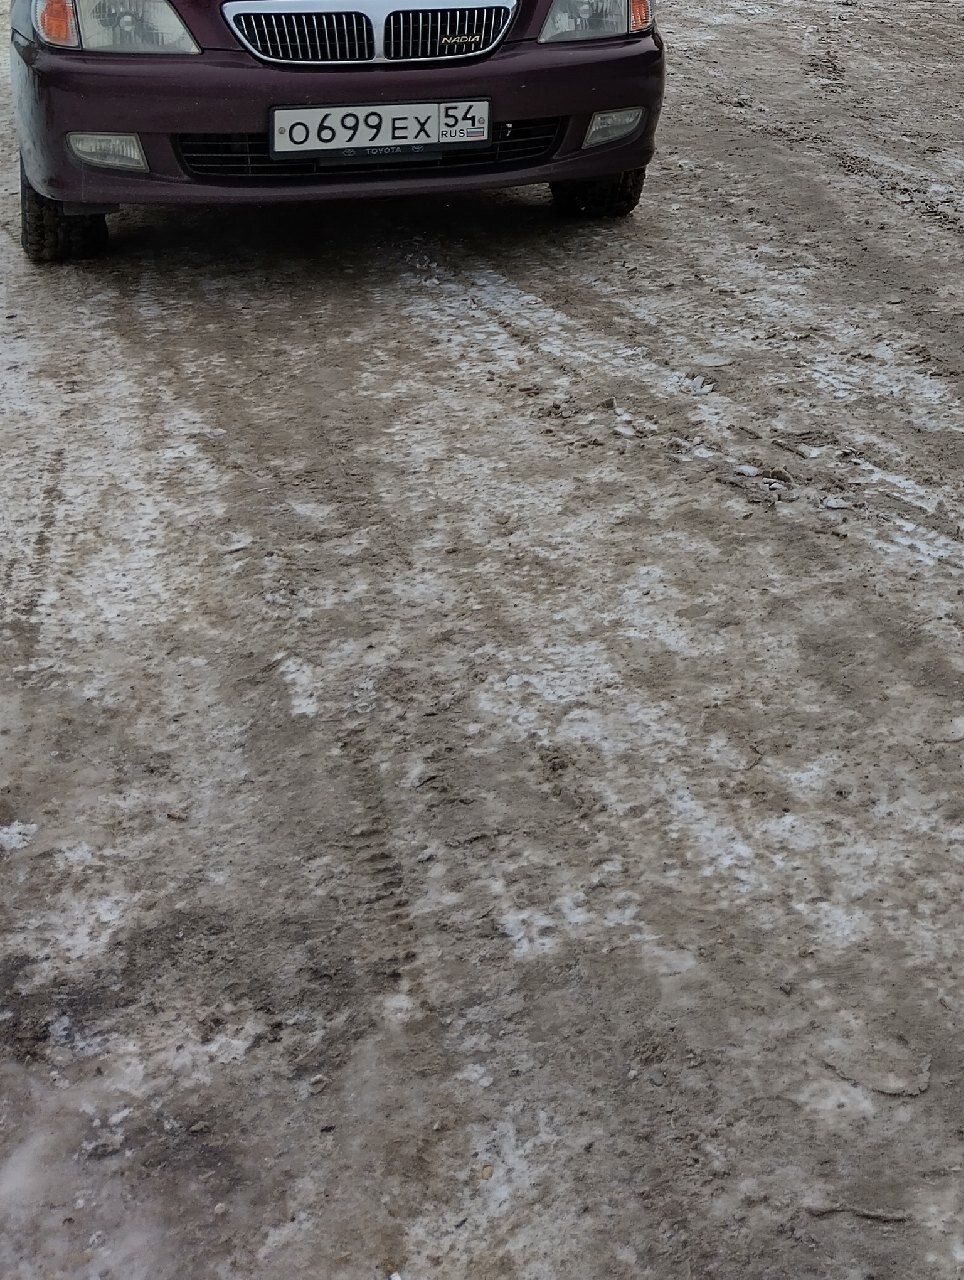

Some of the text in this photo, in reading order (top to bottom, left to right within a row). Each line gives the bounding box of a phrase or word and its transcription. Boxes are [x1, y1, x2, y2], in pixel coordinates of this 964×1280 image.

[442, 35, 481, 44] NADIA
[288, 104, 475, 144] О699ЕХ 54
[441, 129, 466, 138] RUS
[366, 146, 402, 155] TOYOTA
